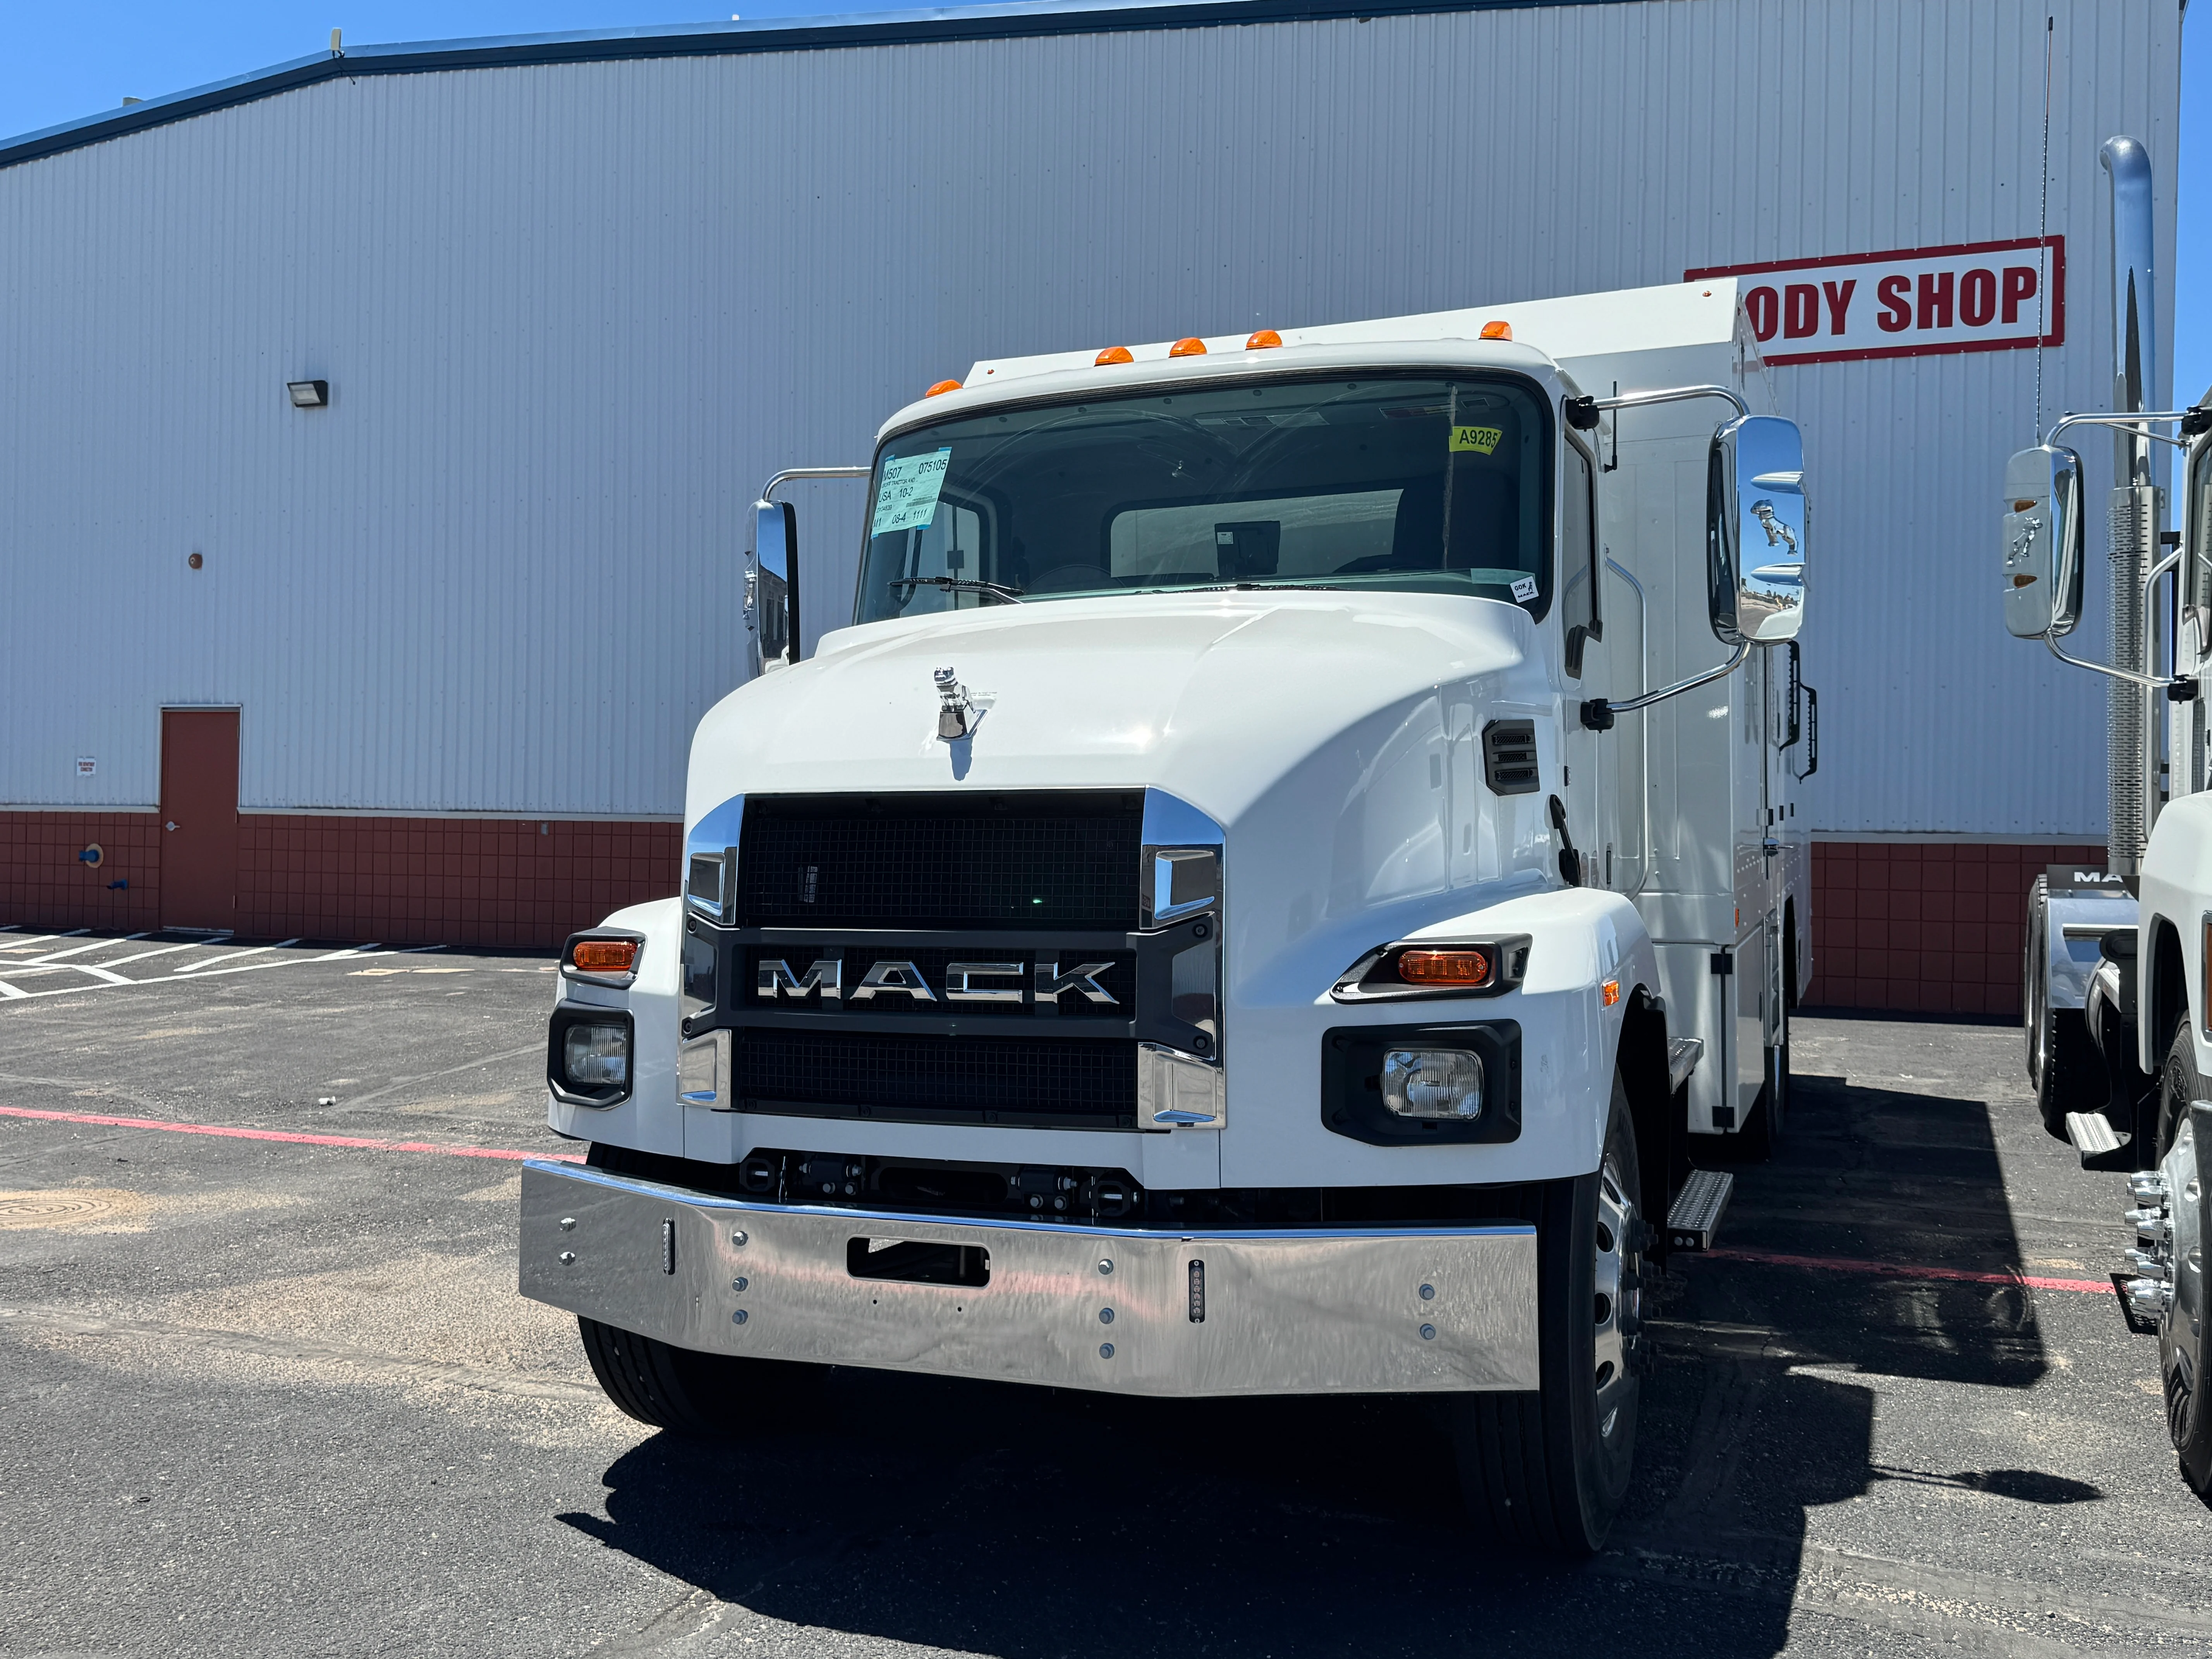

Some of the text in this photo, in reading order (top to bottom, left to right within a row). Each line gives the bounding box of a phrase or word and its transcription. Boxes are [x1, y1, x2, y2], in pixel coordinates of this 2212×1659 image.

[1745, 266, 2037, 342] ODY SHOP
[1459, 429, 1498, 448] A9285
[919, 459, 947, 474] 075105
[879, 487, 913, 503] USA 10-2
[2074, 872, 2123, 882] MA
[758, 958, 1120, 1004] MACK
